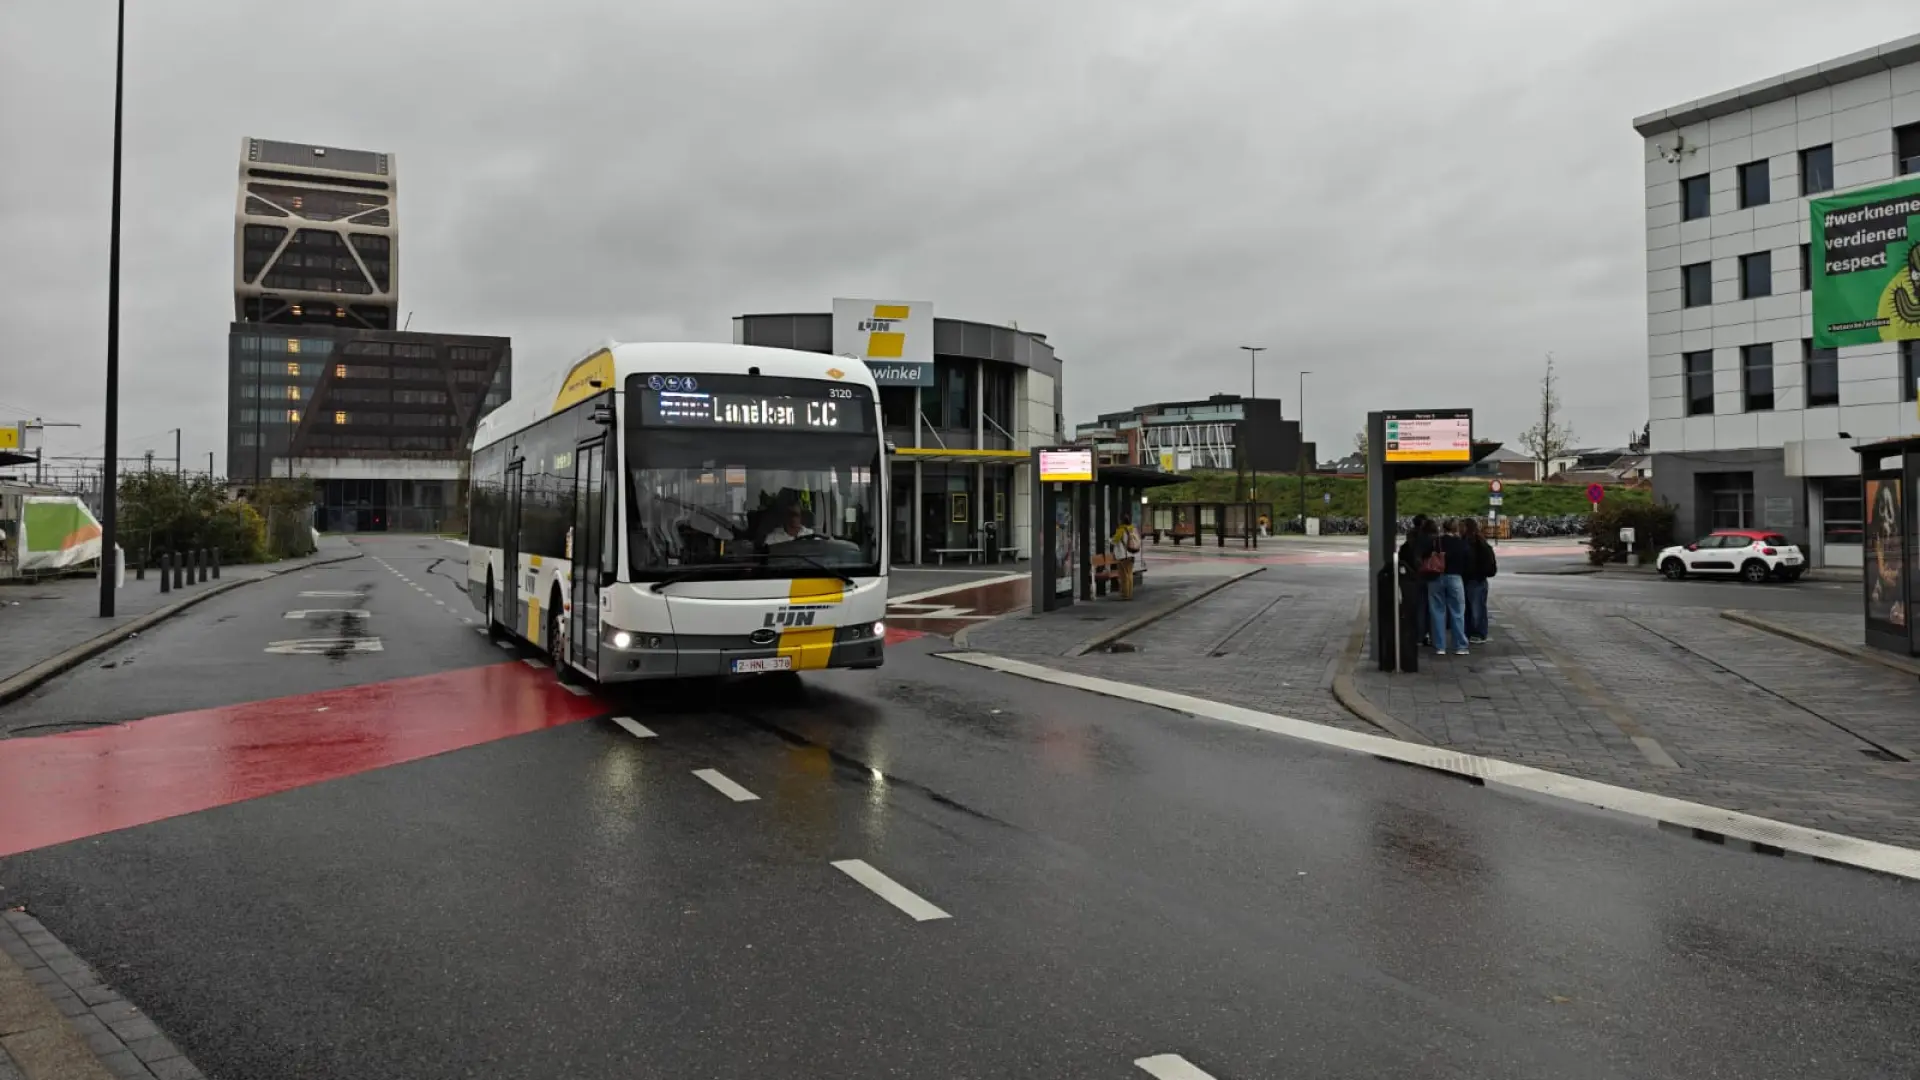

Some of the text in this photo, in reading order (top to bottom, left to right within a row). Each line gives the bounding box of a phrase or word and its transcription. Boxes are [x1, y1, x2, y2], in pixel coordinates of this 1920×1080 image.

[1825, 225, 1908, 250] verdienen
[1826, 251, 1887, 272] respect
[829, 388, 852, 398] 3120
[763, 611, 816, 627] LIJN
